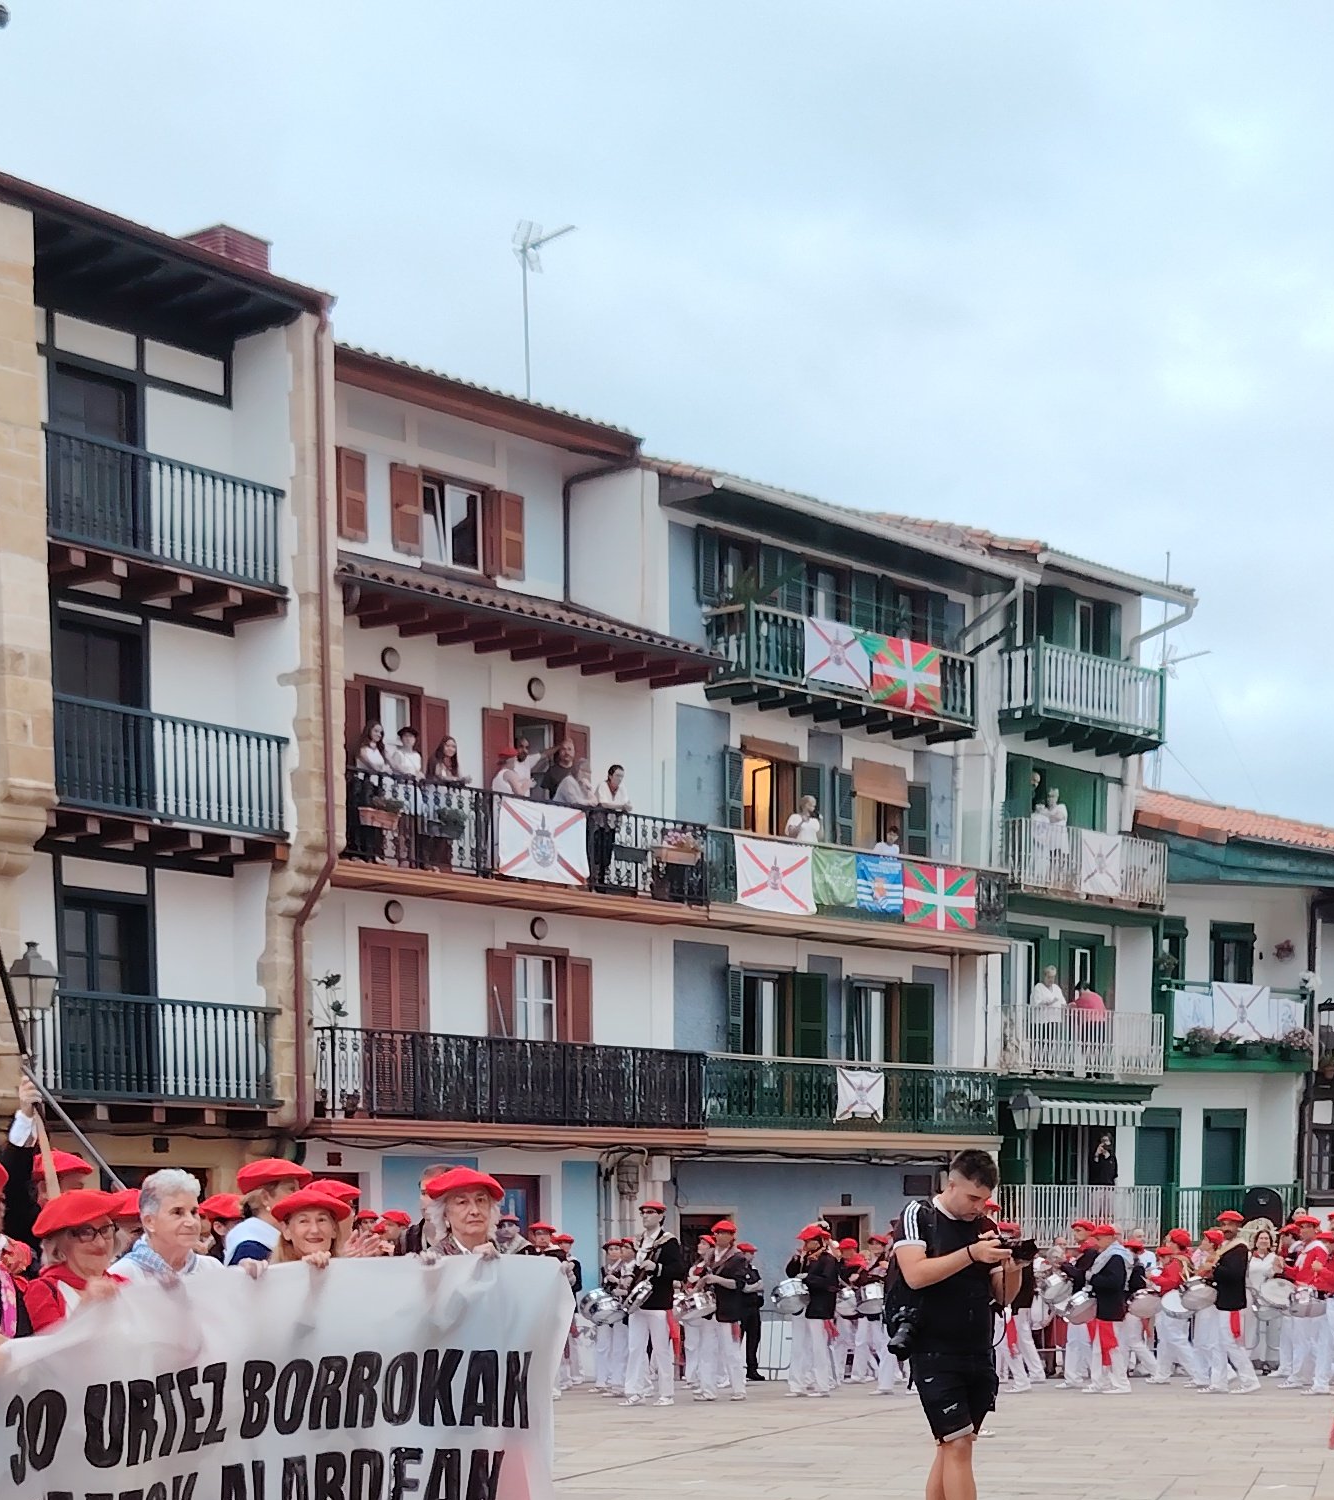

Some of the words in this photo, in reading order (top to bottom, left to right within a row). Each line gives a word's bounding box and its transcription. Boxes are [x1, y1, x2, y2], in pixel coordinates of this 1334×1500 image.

[6, 1389, 67, 1486] 30
[84, 1362, 227, 1468] URTEZ
[240, 1349, 532, 1439] BORROKAN
